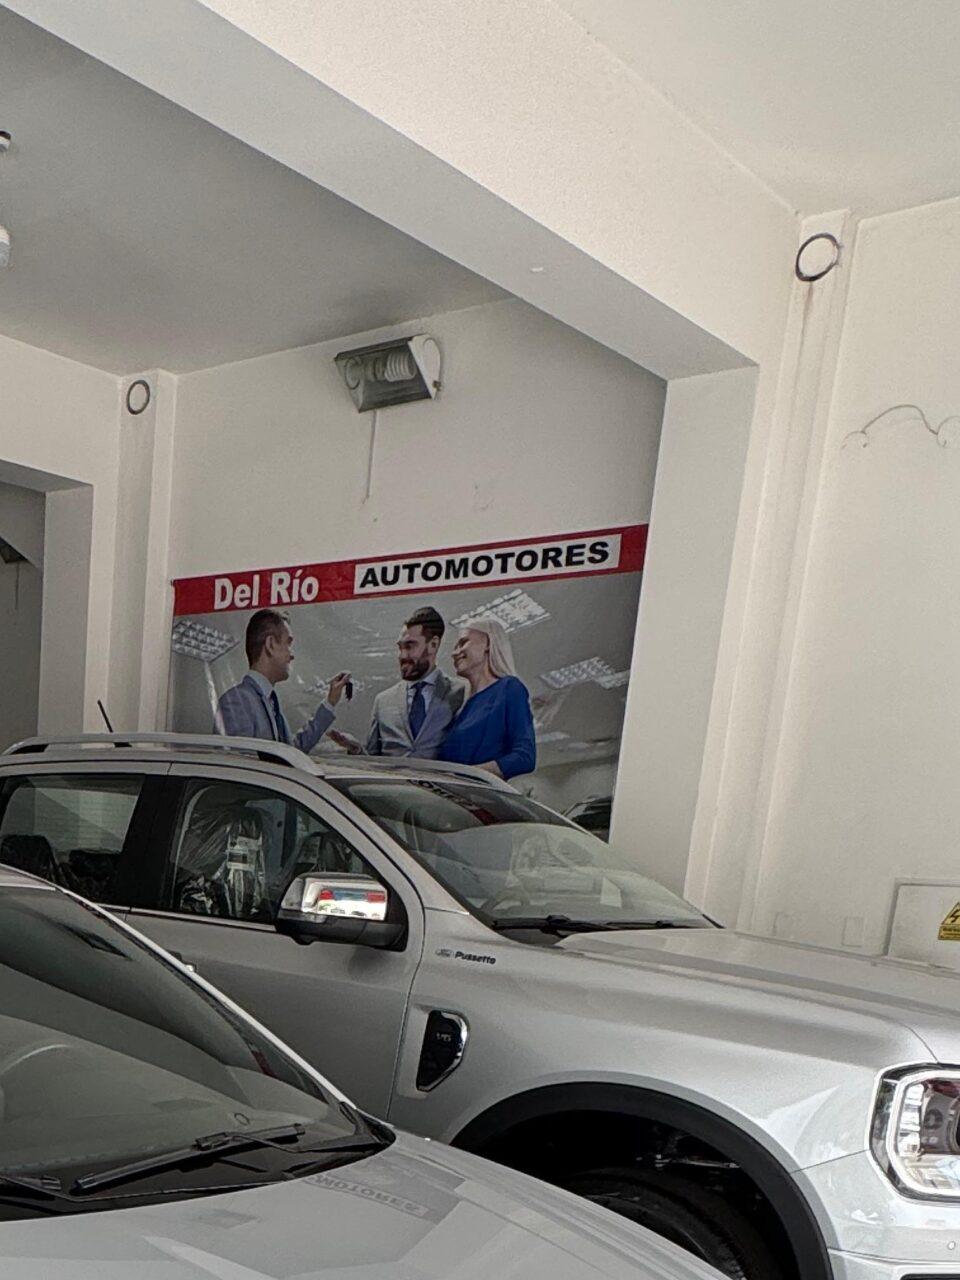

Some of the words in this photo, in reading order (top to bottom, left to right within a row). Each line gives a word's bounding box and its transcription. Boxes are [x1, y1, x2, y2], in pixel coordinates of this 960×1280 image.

[213, 574, 260, 610] Del
[270, 569, 320, 604] Río
[359, 541, 610, 588] AUTOMOTORES
